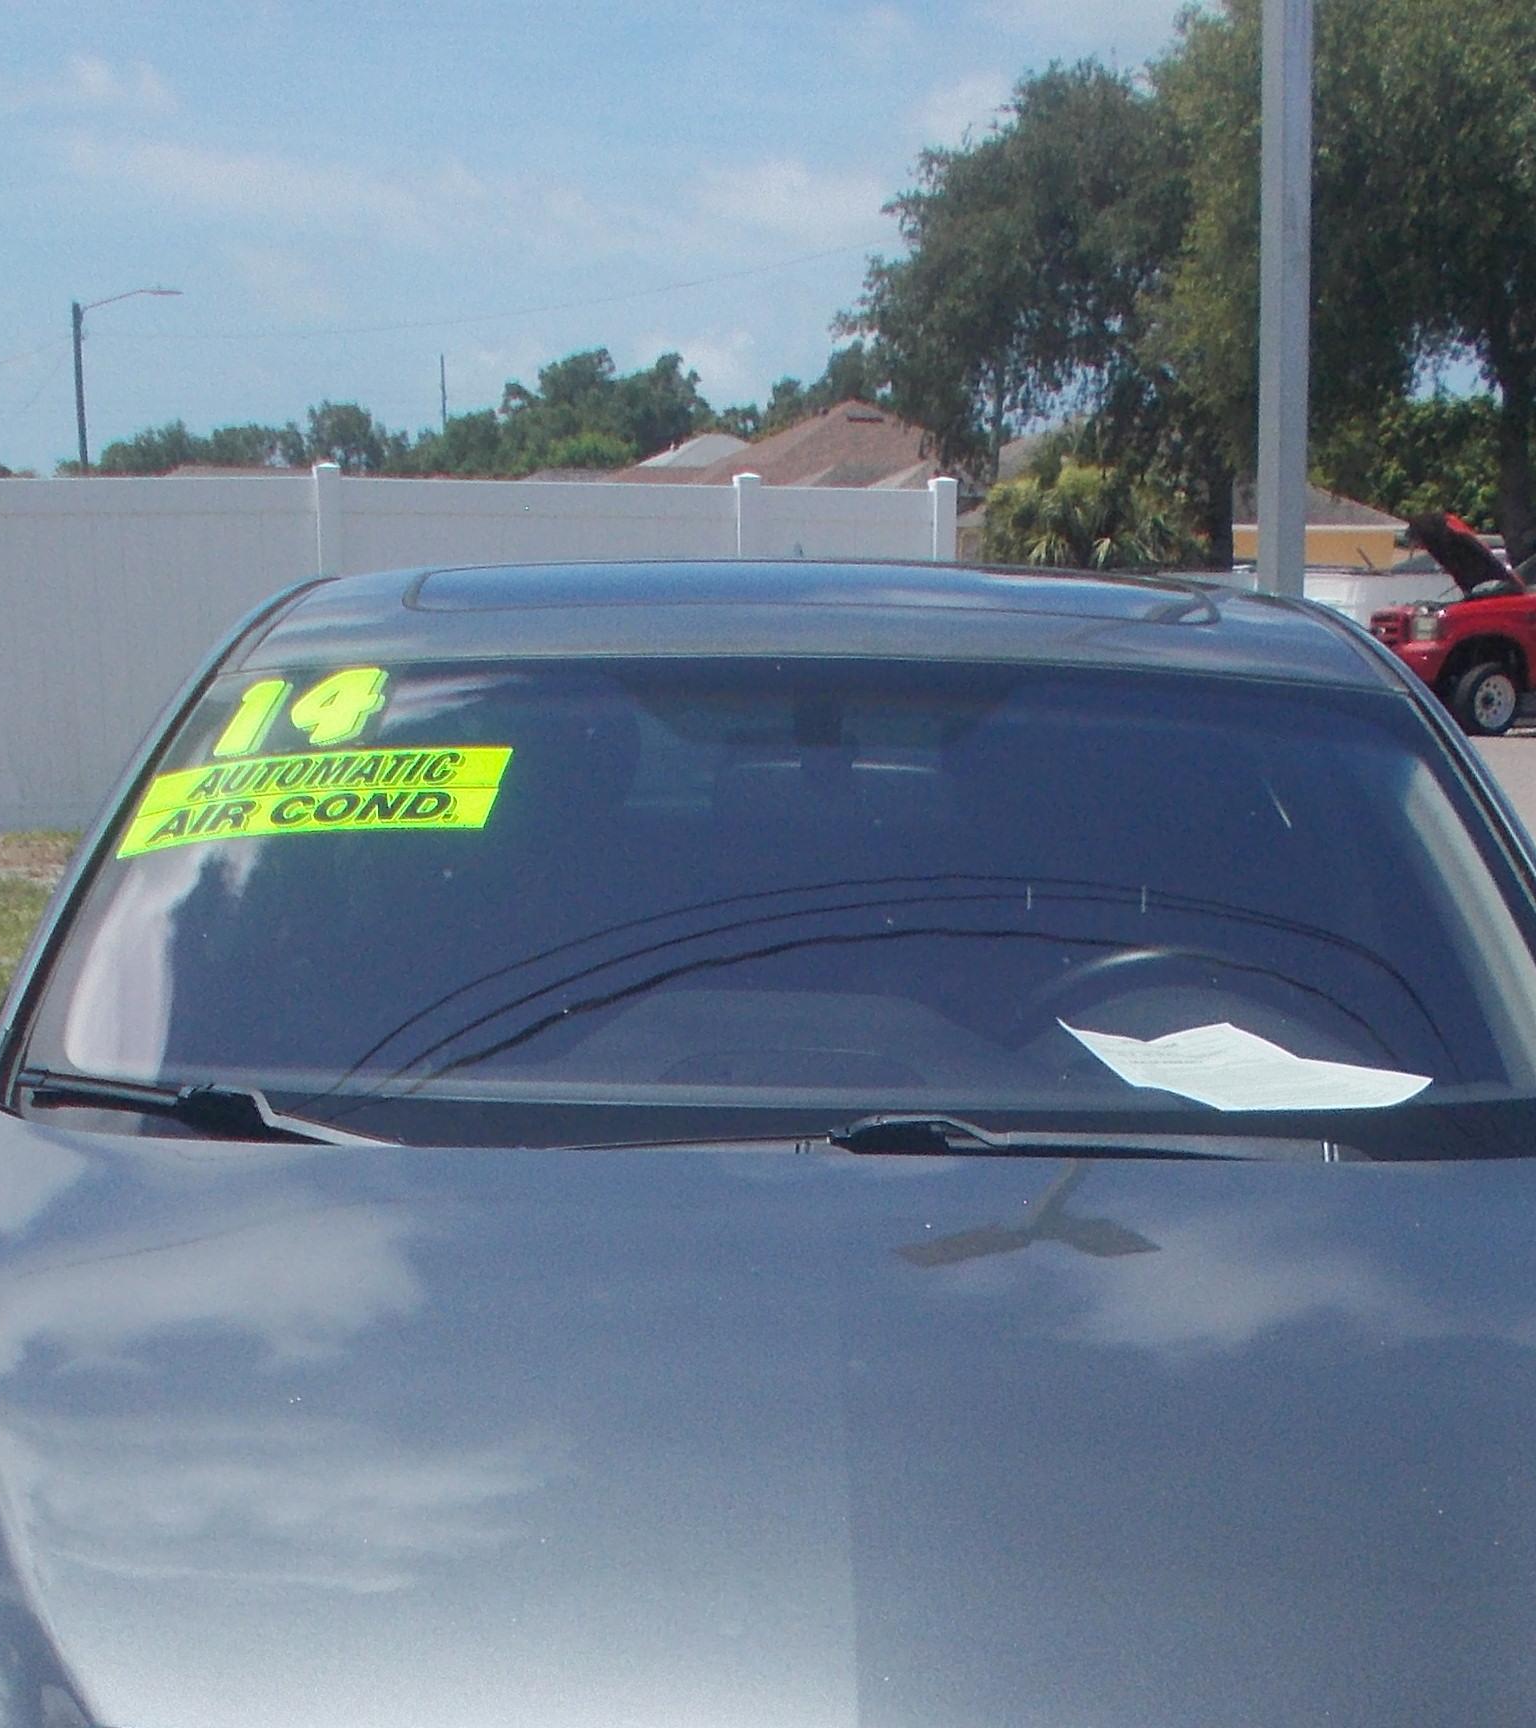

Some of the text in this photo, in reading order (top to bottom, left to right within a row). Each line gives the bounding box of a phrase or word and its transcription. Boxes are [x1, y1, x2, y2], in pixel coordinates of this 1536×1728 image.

[214, 668, 387, 756] 14
[186, 751, 464, 800] AUTOMATIC
[145, 791, 457, 847] AIR COND.
